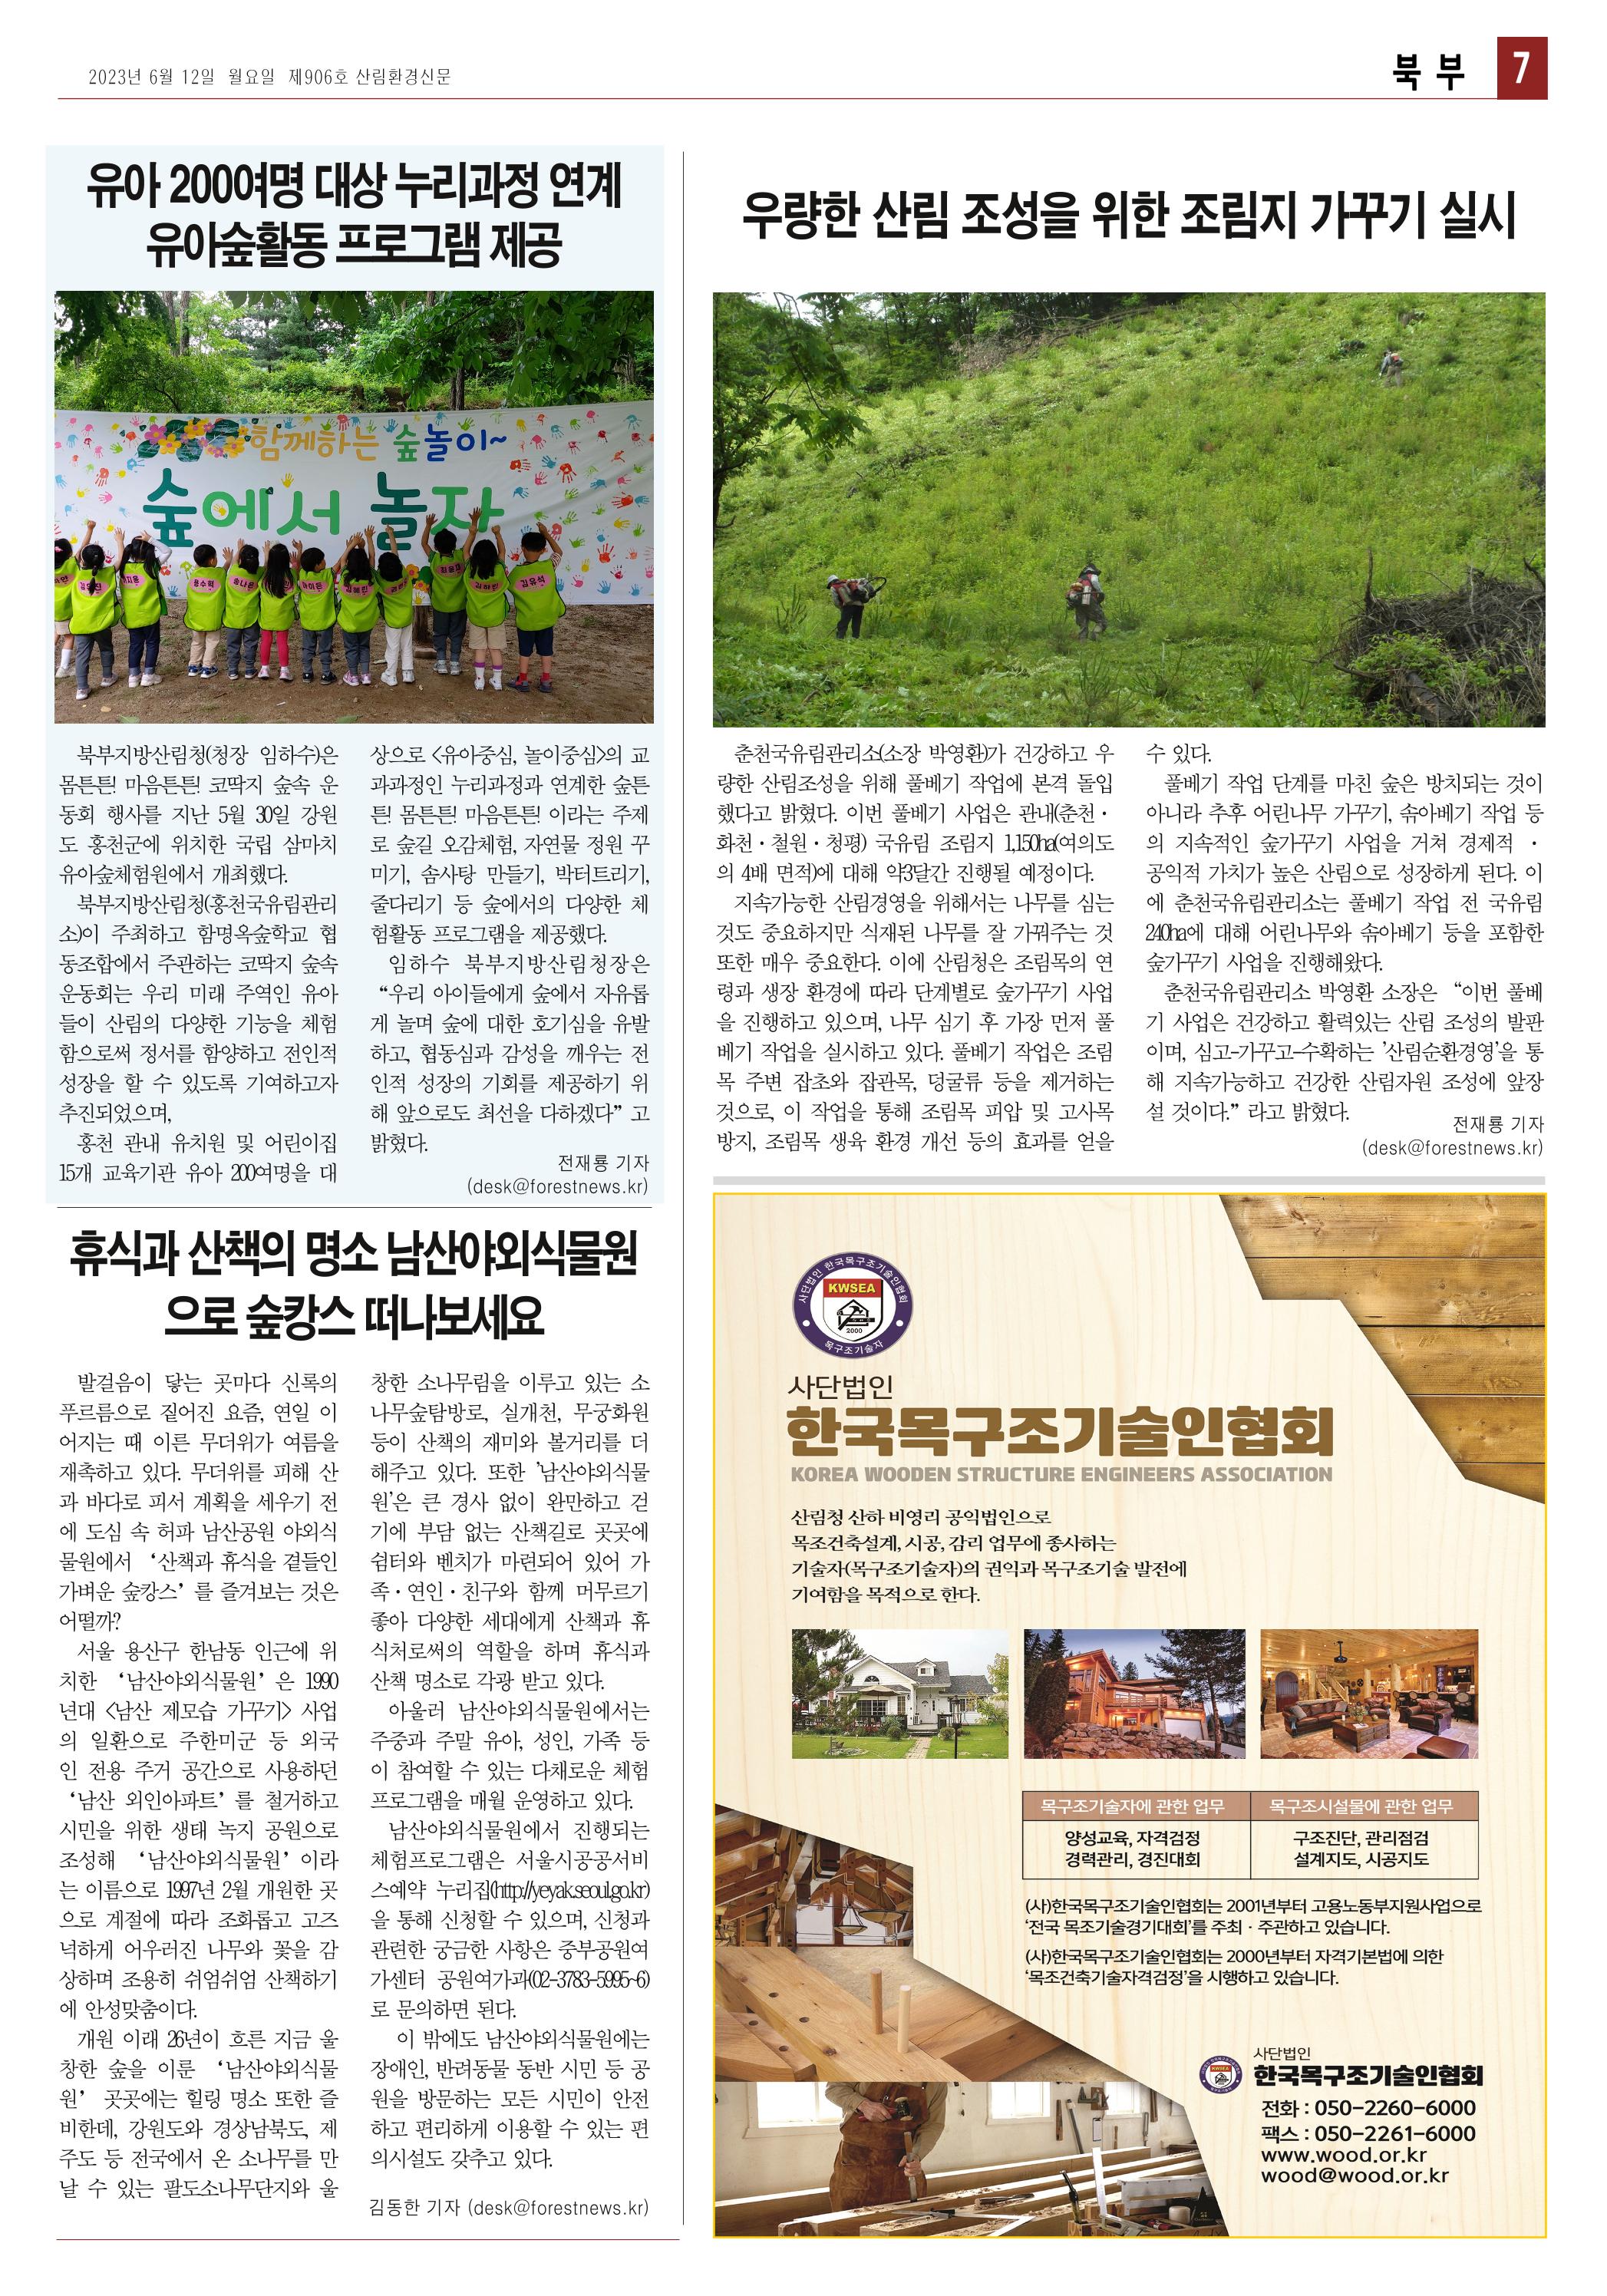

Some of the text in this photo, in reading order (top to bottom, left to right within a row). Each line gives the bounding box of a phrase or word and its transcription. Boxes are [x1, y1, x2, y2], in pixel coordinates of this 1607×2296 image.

[88, 68, 451, 86] 2023년 6월 12일 월요일 제906호 산림환경신문
[1513, 51, 1530, 84] 7
[87, 161, 622, 209] 유아 200여명 대상 누리과정 연계
[742, 190, 1516, 240] 우량한 산림 조성을 위한 조림지 가꾸기 실시
[146, 220, 563, 269] 유아숲활동 프로그램 제공
[251, 424, 380, 462] 함께하는
[143, 467, 505, 551] 숲에서 놀자
[520, 575, 546, 588] 김유석
[76, 744, 339, 767] 북부지방산림청(청장 임하수)은
[734, 743, 1115, 765] 춘천국유림관리소(소장 박영환)가 건강하고 우
[58, 774, 339, 797] 몸튼튼! 마음튼튼! 코딱지 숲속 운
[370, 1043, 649, 1065] 하고, 협동심과 감성을 깨우는 전
[1146, 1100, 1350, 1123] 설 것이다.” 라고 밝혔다.
[1453, 1115, 1545, 1134] 전재룡 기자
[370, 1132, 428, 1154] 밝혔다.
[1362, 1138, 1543, 1157] (desk@forestnews.kr)
[558, 1154, 650, 1173] 전재룡 기자
[467, 1176, 648, 1196] (desk@forestnews.kr)
[70, 1229, 638, 1278] 휴식과 산책의 명소 남산야외식물원
[798, 1256, 909, 1304] 사단법인 한국목구조기술인협회
[828, 1283, 876, 1294] KWSEA
[164, 1293, 546, 1341] 으로 숲캉스 떠나보세요
[824, 1340, 884, 1355] 목구조기술자
[77, 1371, 336, 1394] 발걸음이 닿는 곳마다 신록의
[787, 1374, 893, 1400] 사단법인
[786, 1405, 1334, 1457] 한국목구조기술인협회
[791, 1466, 1332, 1483] KOREA WOODEN STRUCTURE ENGINEERS ASSOCIATION
[790, 1508, 1052, 1527] 산림청 산하 비영리 공익법인으로
[791, 1534, 1117, 1553] 목조건축설계, 시공, 감리 업무에 종사하는
[791, 1560, 1187, 1578] 기술자(목구조기술자)의 권익과 목구조기술 발전에
[791, 1585, 981, 1604] 기여함을 목적으로 한다.
[1041, 1798, 1226, 1815] 목구조기술자에 관한 업무
[1269, 1798, 1454, 1815] 목구조시설물에 관한 업무
[1064, 1830, 1200, 1849] 양성교육, 자격검정
[1293, 1830, 1429, 1849] 구조진단, 관리점검
[1064, 1851, 1200, 1870] 경력관리, 경진대회
[1293, 1852, 1430, 1870] 설계지도, 시공지도
[1025, 1898, 1483, 1915] (사)한국목구조기술인협회는 2001년부터 고용노동부지원사업으로
[1025, 1918, 1391, 1936] ‘전국 목조기술경기대회’를 주최 주관하고 있습니다.
[1025, 1948, 1445, 1965] (사)한국목구조기술인협회는 2000년부터 자격기본법에 의한
[1025, 1968, 1339, 1987] ‘목조건축기술자격검정’을 시행하고 있습니다.
[370, 1998, 516, 2021] 로 문의하면 된다.
[1252, 2047, 1311, 2061] 사단법인
[1253, 2063, 1483, 2087] 한국목구조기술인협회
[1261, 2099, 1300, 2119] 전화
[1315, 2099, 1477, 2116] 050-2260-6000
[1261, 2125, 1300, 2145] 팩스
[1315, 2125, 1477, 2143] 050-2261-6000
[370, 2148, 553, 2170] 의시설도 갖추고 있다.
[1260, 2146, 1427, 2164] www.wood.or.kr
[1260, 2166, 1450, 2184] wood@wood.or.kr
[369, 2198, 648, 2217] 김동한 기자 (desk@forestnews.kr)
